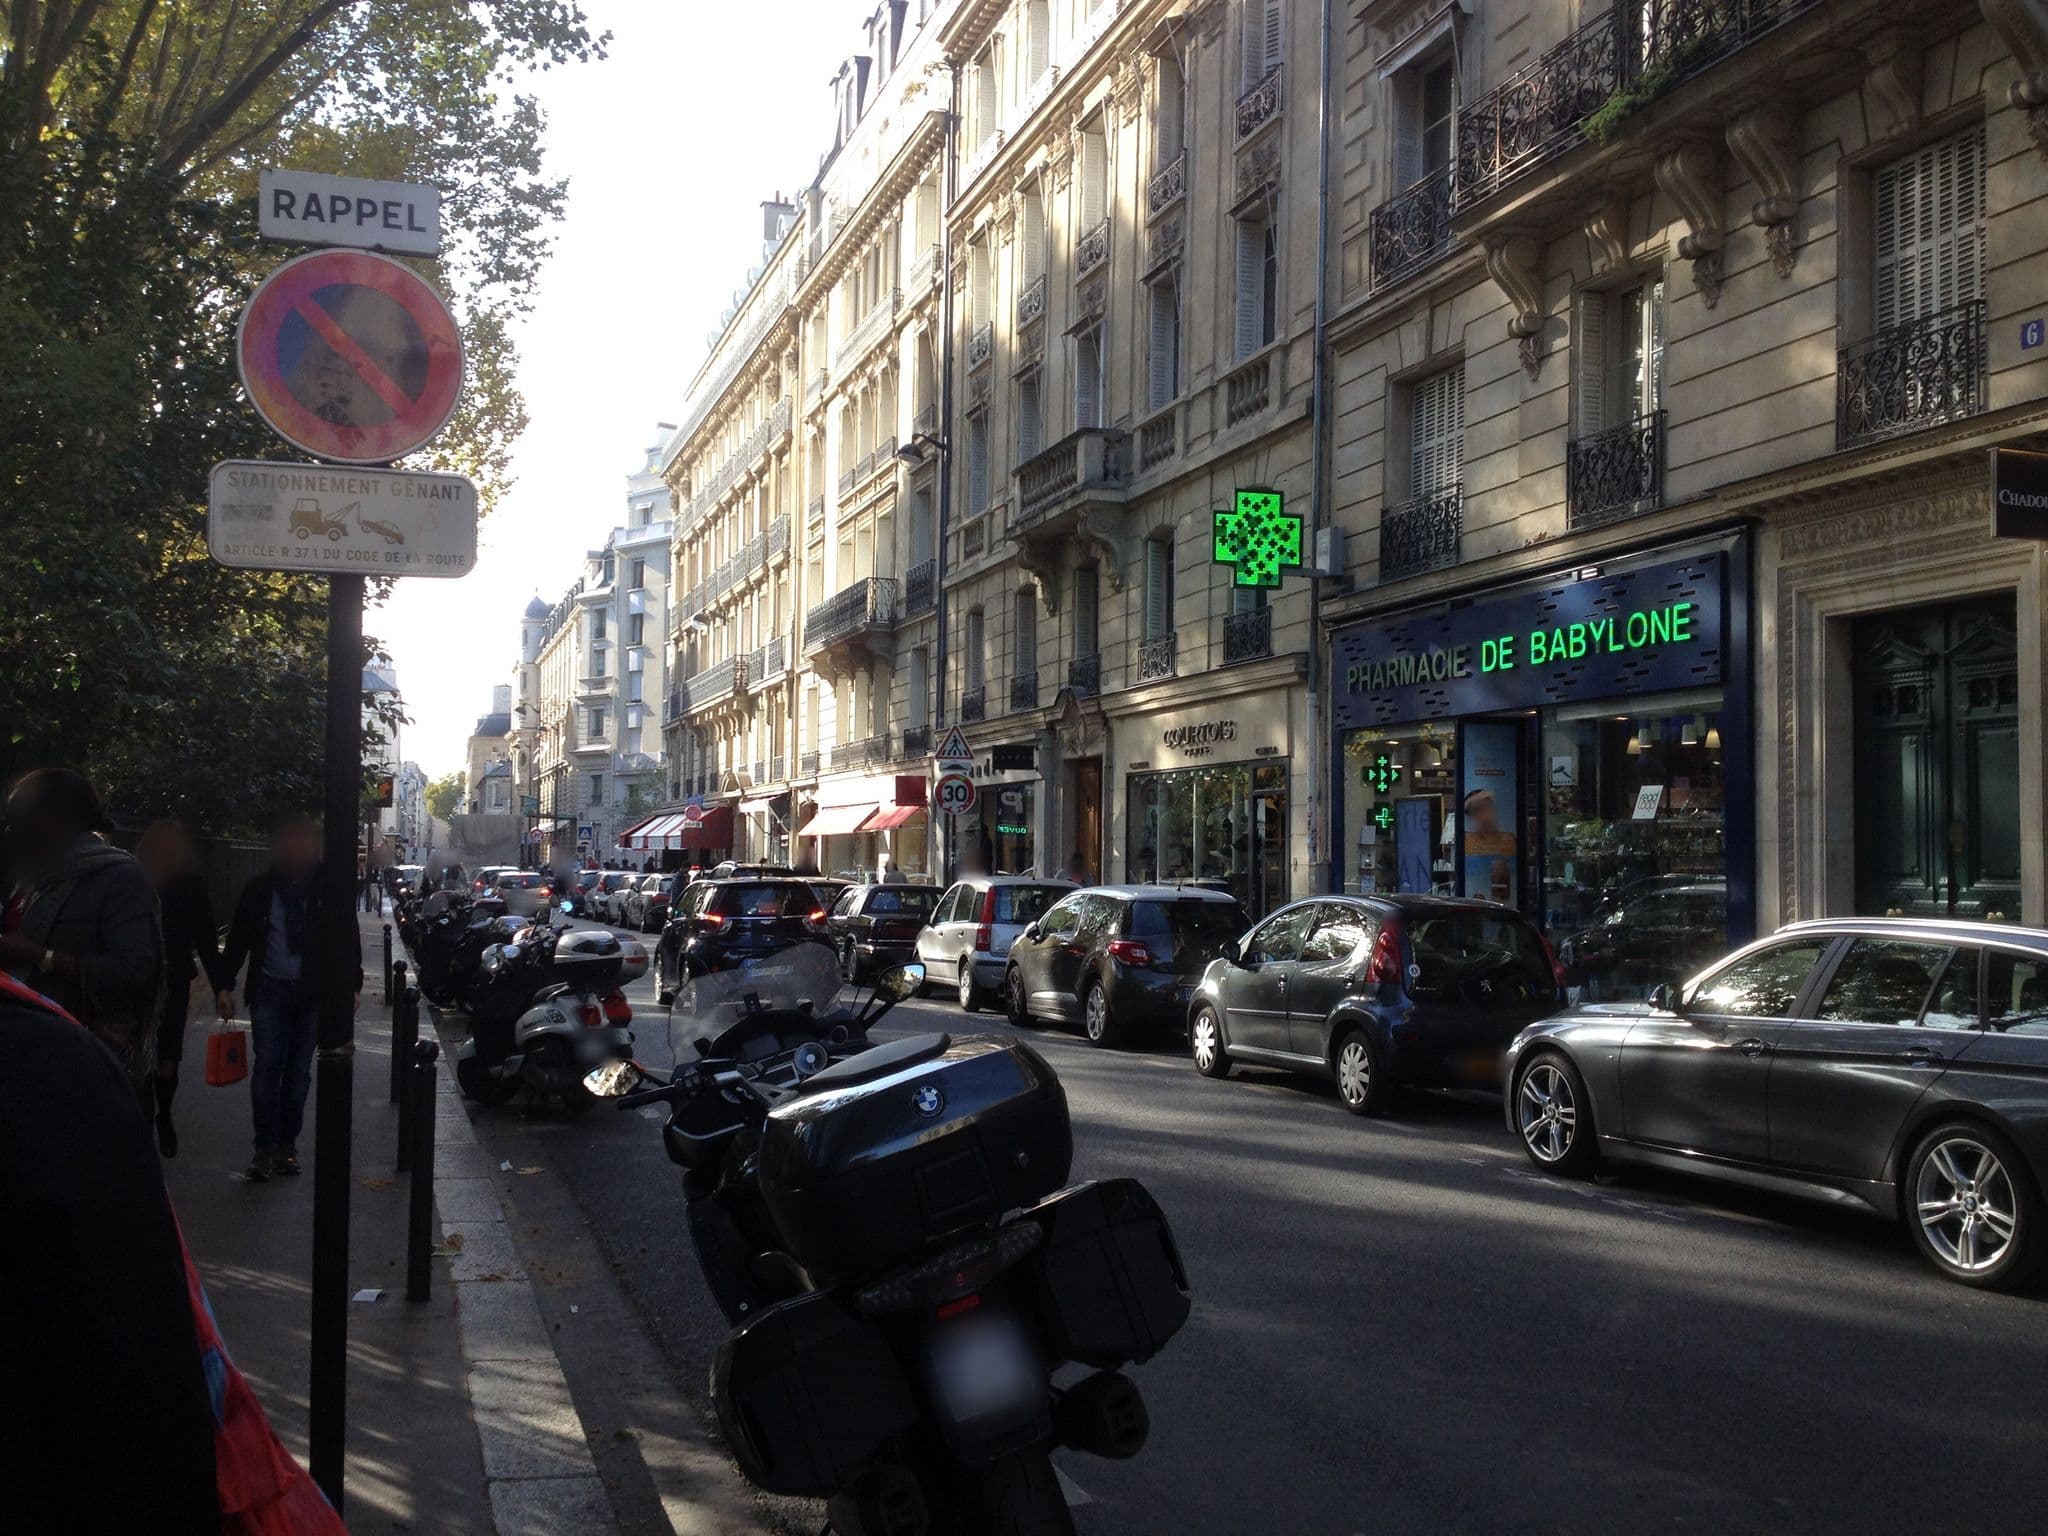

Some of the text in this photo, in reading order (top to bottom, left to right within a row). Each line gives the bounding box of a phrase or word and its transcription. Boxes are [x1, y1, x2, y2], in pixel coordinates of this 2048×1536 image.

[273, 188, 427, 234] RAPPEL
[2026, 322, 2038, 345] 6
[226, 471, 463, 501] STATIONNEMENT GÊNANT
[223, 543, 275, 558] ARTICLE
[281, 546, 289, 558] R
[324, 548, 340, 560] DU
[347, 547, 379, 562] CODE
[385, 551, 400, 564] DE
[406, 552, 421, 564] LA
[427, 554, 465, 567] ROUTE
[1347, 602, 1692, 693] PHARMACIE DE BABYLONE
[1164, 720, 1236, 748] COURTOIS
[943, 784, 968, 803] 30
